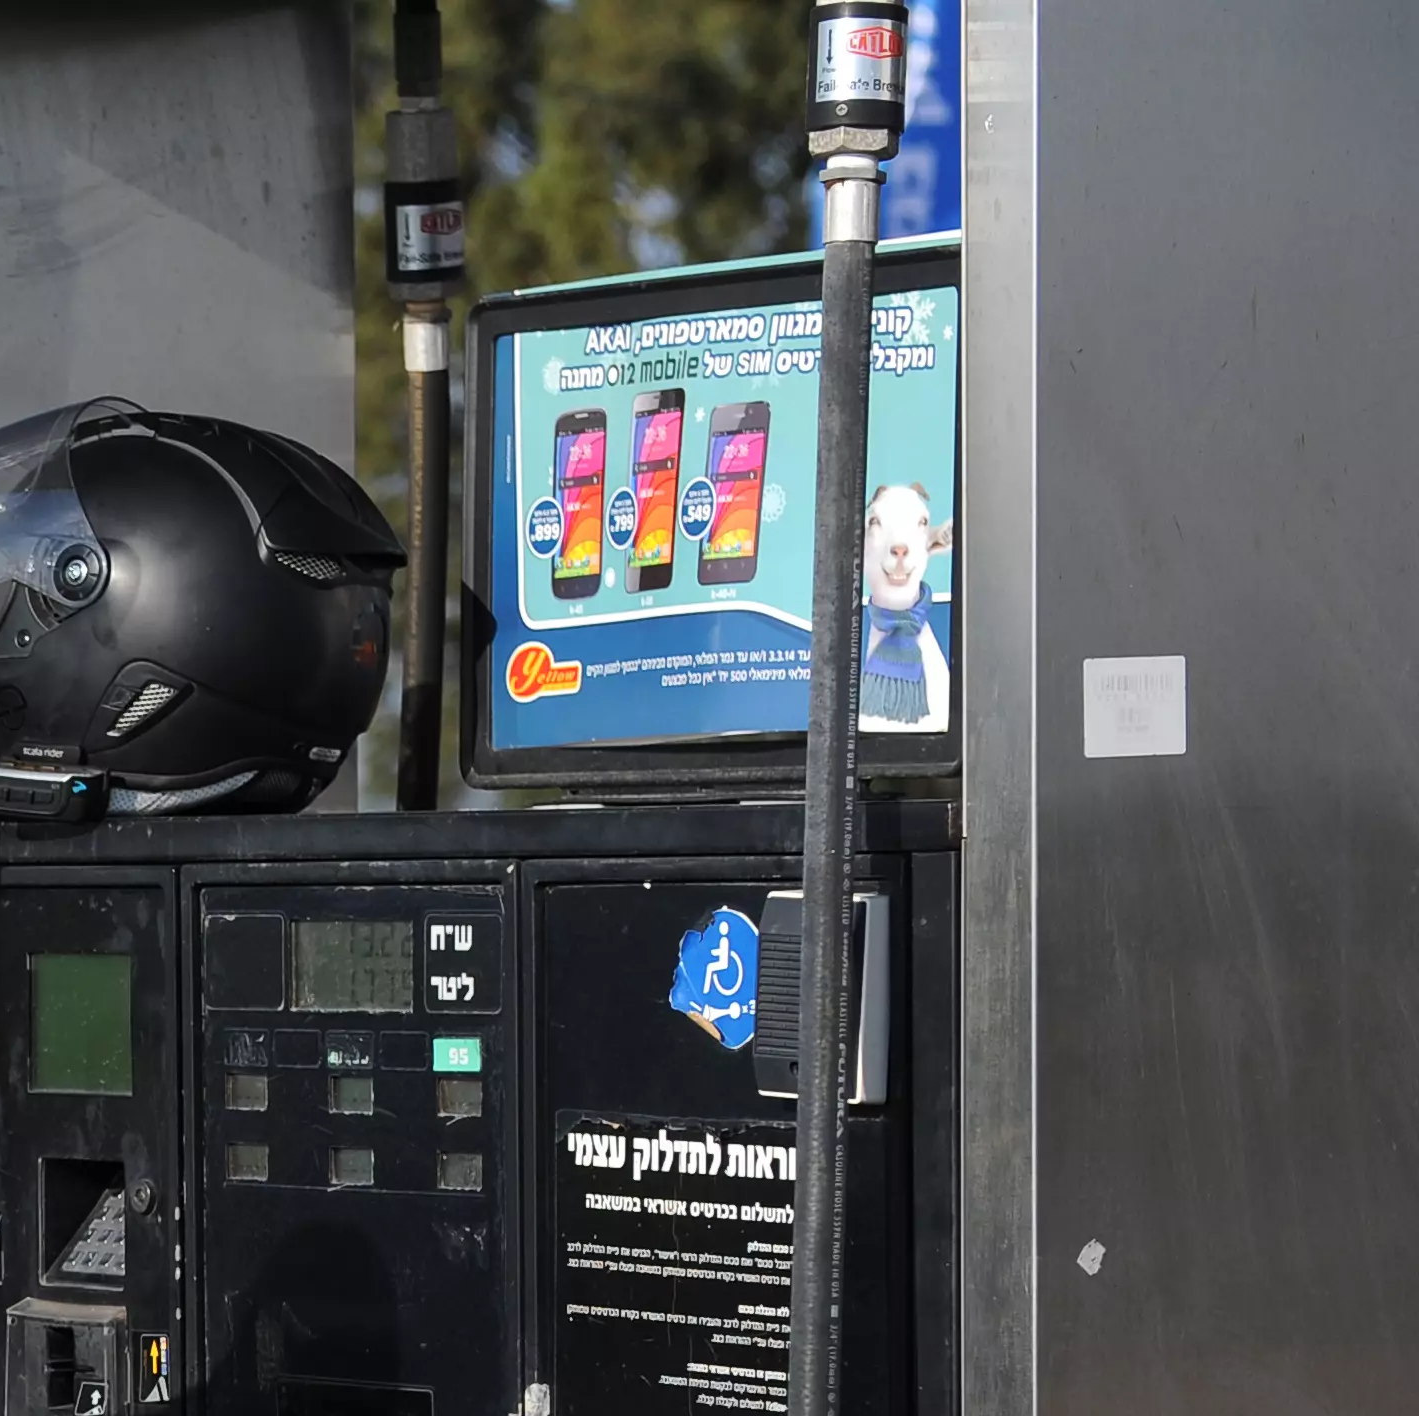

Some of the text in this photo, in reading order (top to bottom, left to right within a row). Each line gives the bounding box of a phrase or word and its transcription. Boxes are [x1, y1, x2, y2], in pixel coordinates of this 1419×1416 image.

[584, 325, 632, 355] AKAI
[560, 363, 606, 391] מתנה
[638, 350, 699, 384] mobile
[703, 349, 734, 380] של
[735, 351, 772, 375] SIM
[730, 670, 747, 682] 500
[23, 747, 64, 758] scala rider
[430, 924, 472, 951] ש"ח
[430, 973, 475, 1001] ליטר
[448, 1047, 469, 1065] 95
[567, 1129, 797, 1181] וראות לתדלוק עצמי
[585, 1193, 795, 1224] לתשלום בכרטיס אשראי במשאבה
